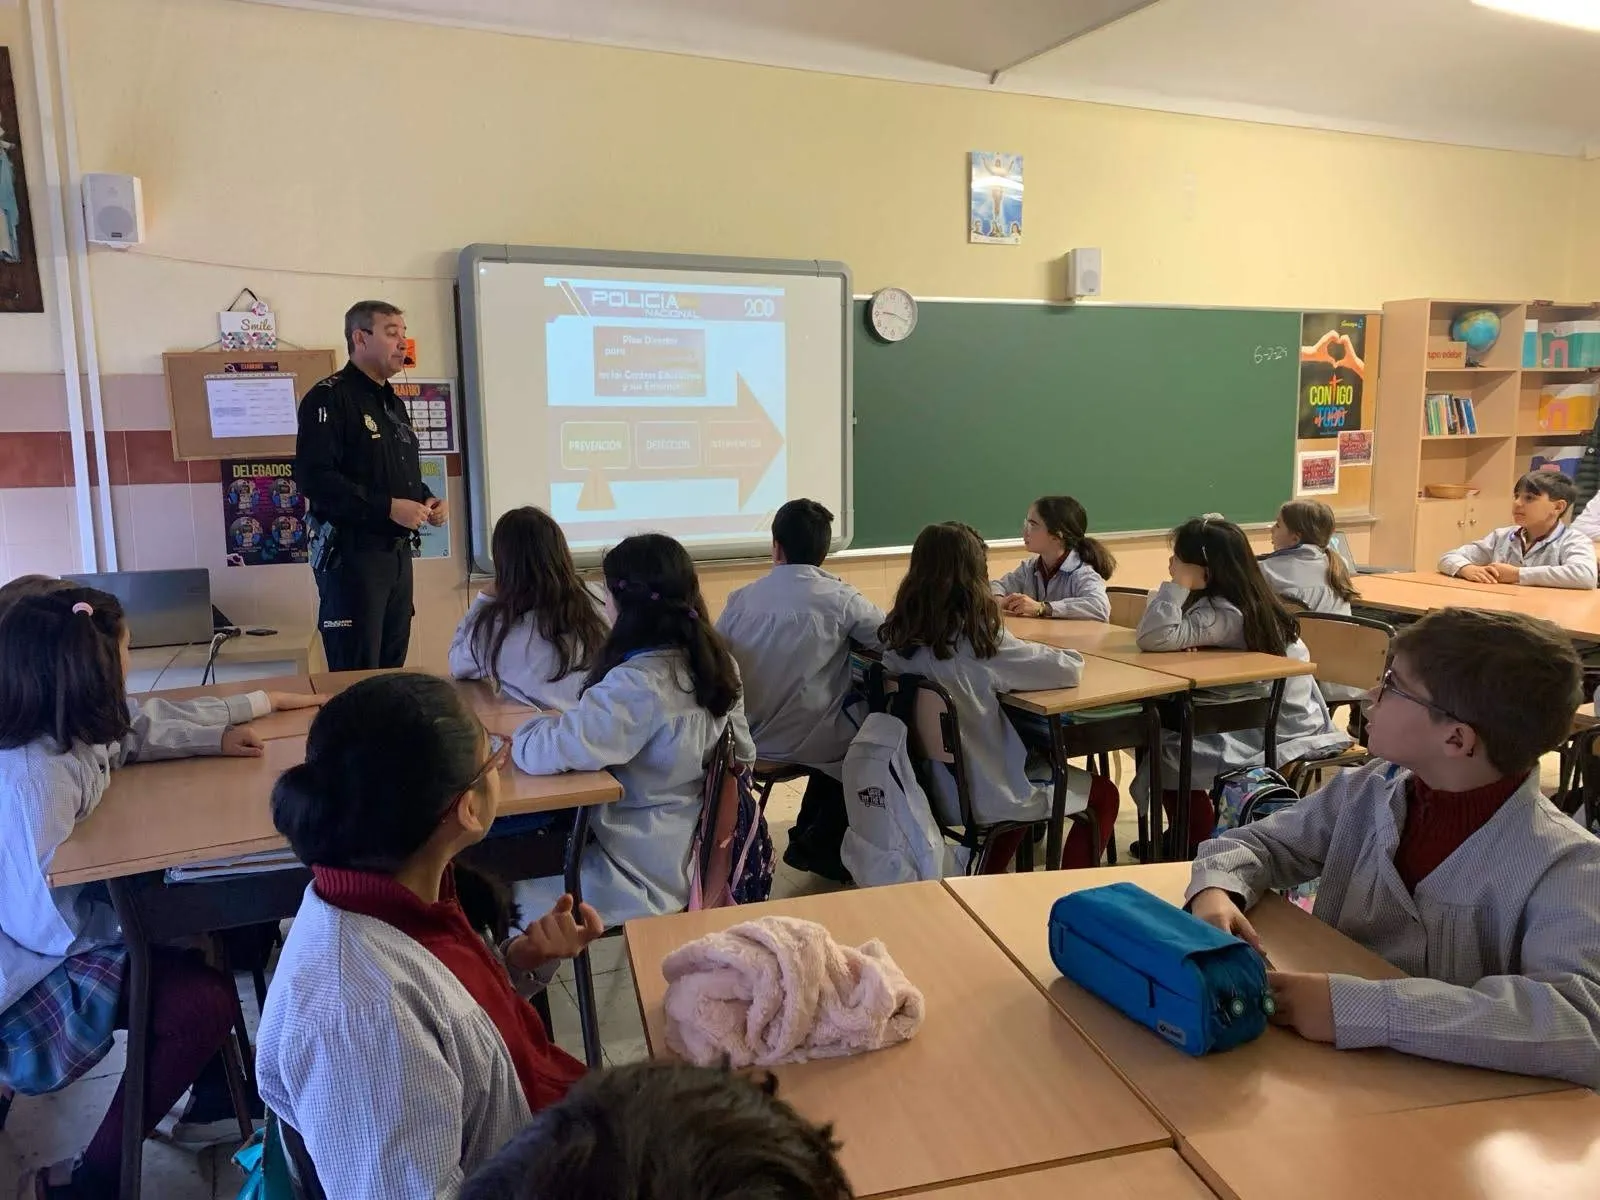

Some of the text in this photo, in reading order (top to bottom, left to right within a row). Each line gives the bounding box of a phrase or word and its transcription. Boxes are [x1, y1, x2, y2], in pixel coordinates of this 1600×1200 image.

[744, 298, 774, 317] 200
[241, 318, 273, 331] Smile
[232, 463, 293, 478] DELEGADOS
